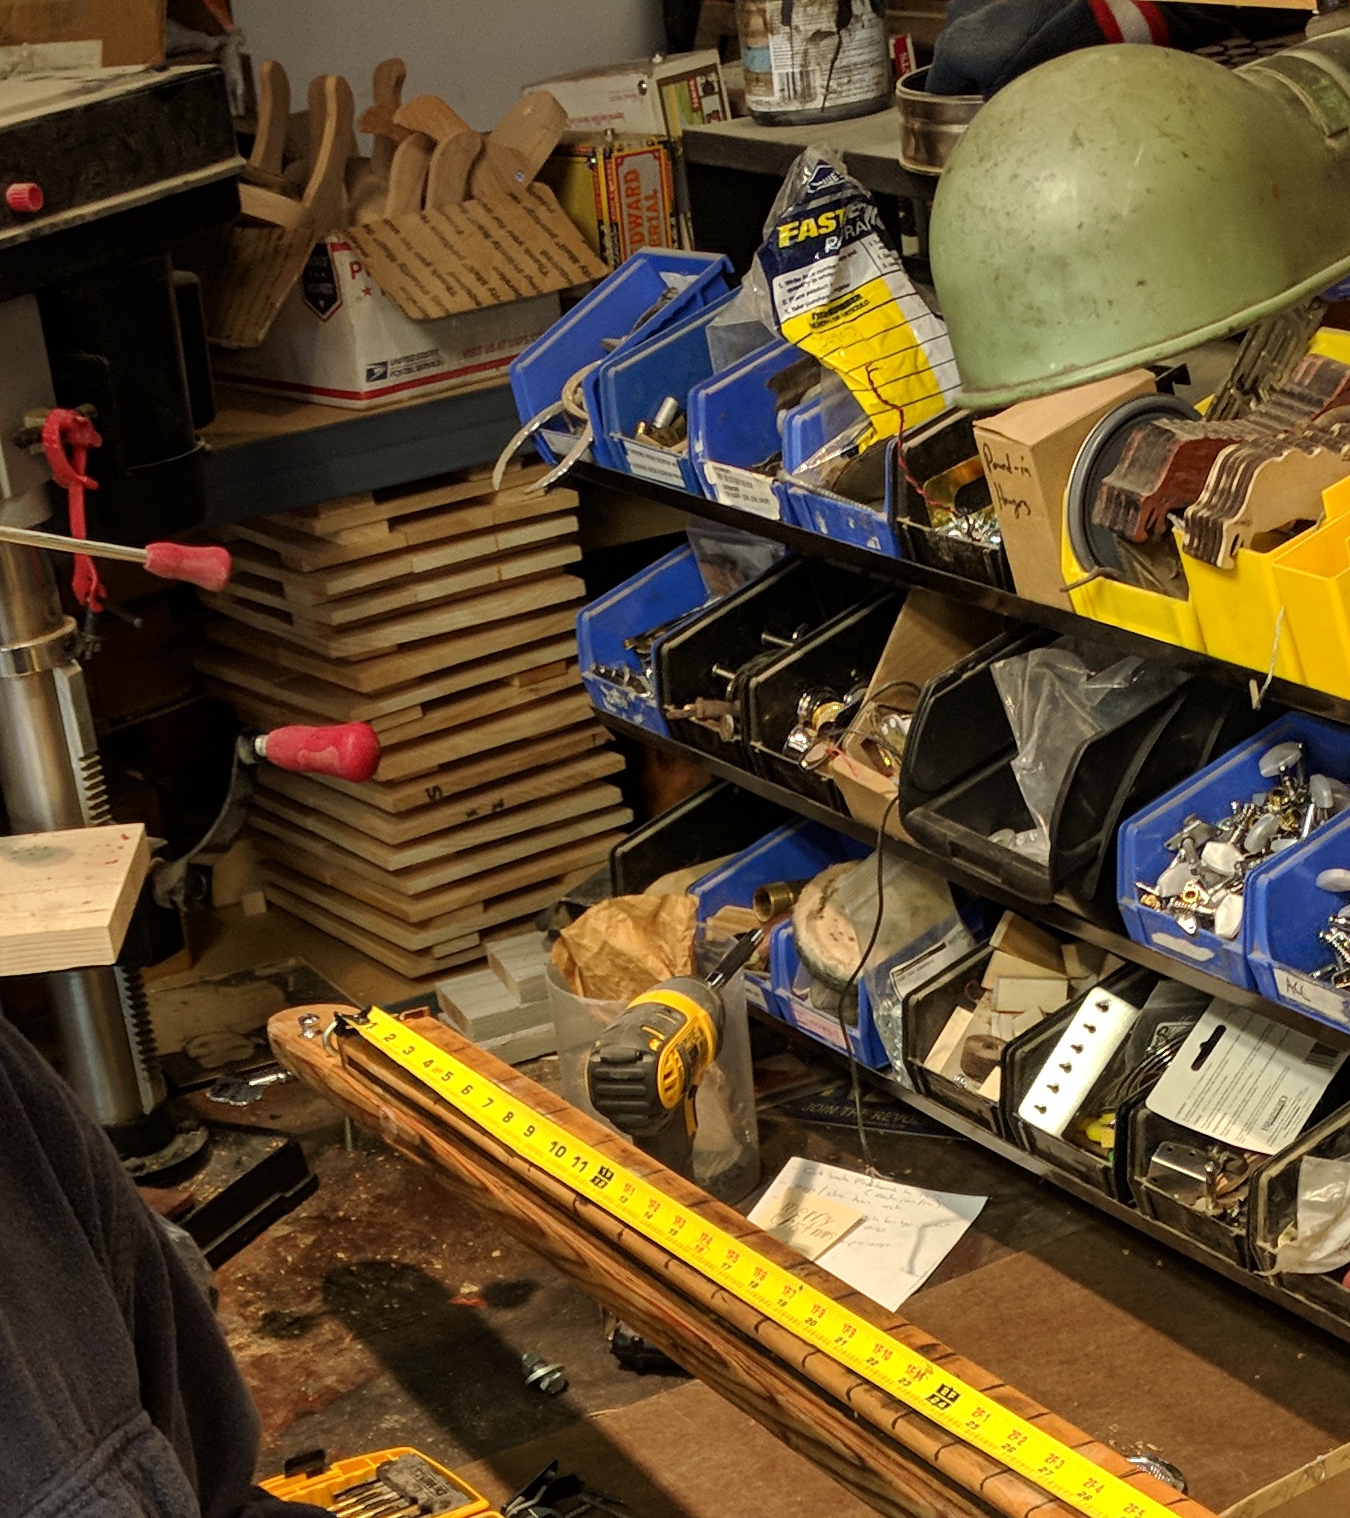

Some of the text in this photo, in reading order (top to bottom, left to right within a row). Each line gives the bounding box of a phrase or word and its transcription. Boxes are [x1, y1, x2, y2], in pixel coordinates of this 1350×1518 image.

[383, 1032, 397, 1043] 2
[402, 1045, 415, 1056] 3
[423, 1059, 435, 1069] 4
[441, 1071, 454, 1082] 5
[460, 1084, 473, 1096] 6
[481, 1097, 494, 1109] 7
[502, 1112, 515, 1124] 8
[523, 1125, 536, 1138] 9
[549, 1140, 567, 1159] 10
[571, 1155, 589, 1173] 11
[965, 1420, 981, 1431] 25
[1001, 1443, 1017, 1453] 26
[1037, 1465, 1055, 1476] 27
[1077, 1491, 1093, 1501] 28
